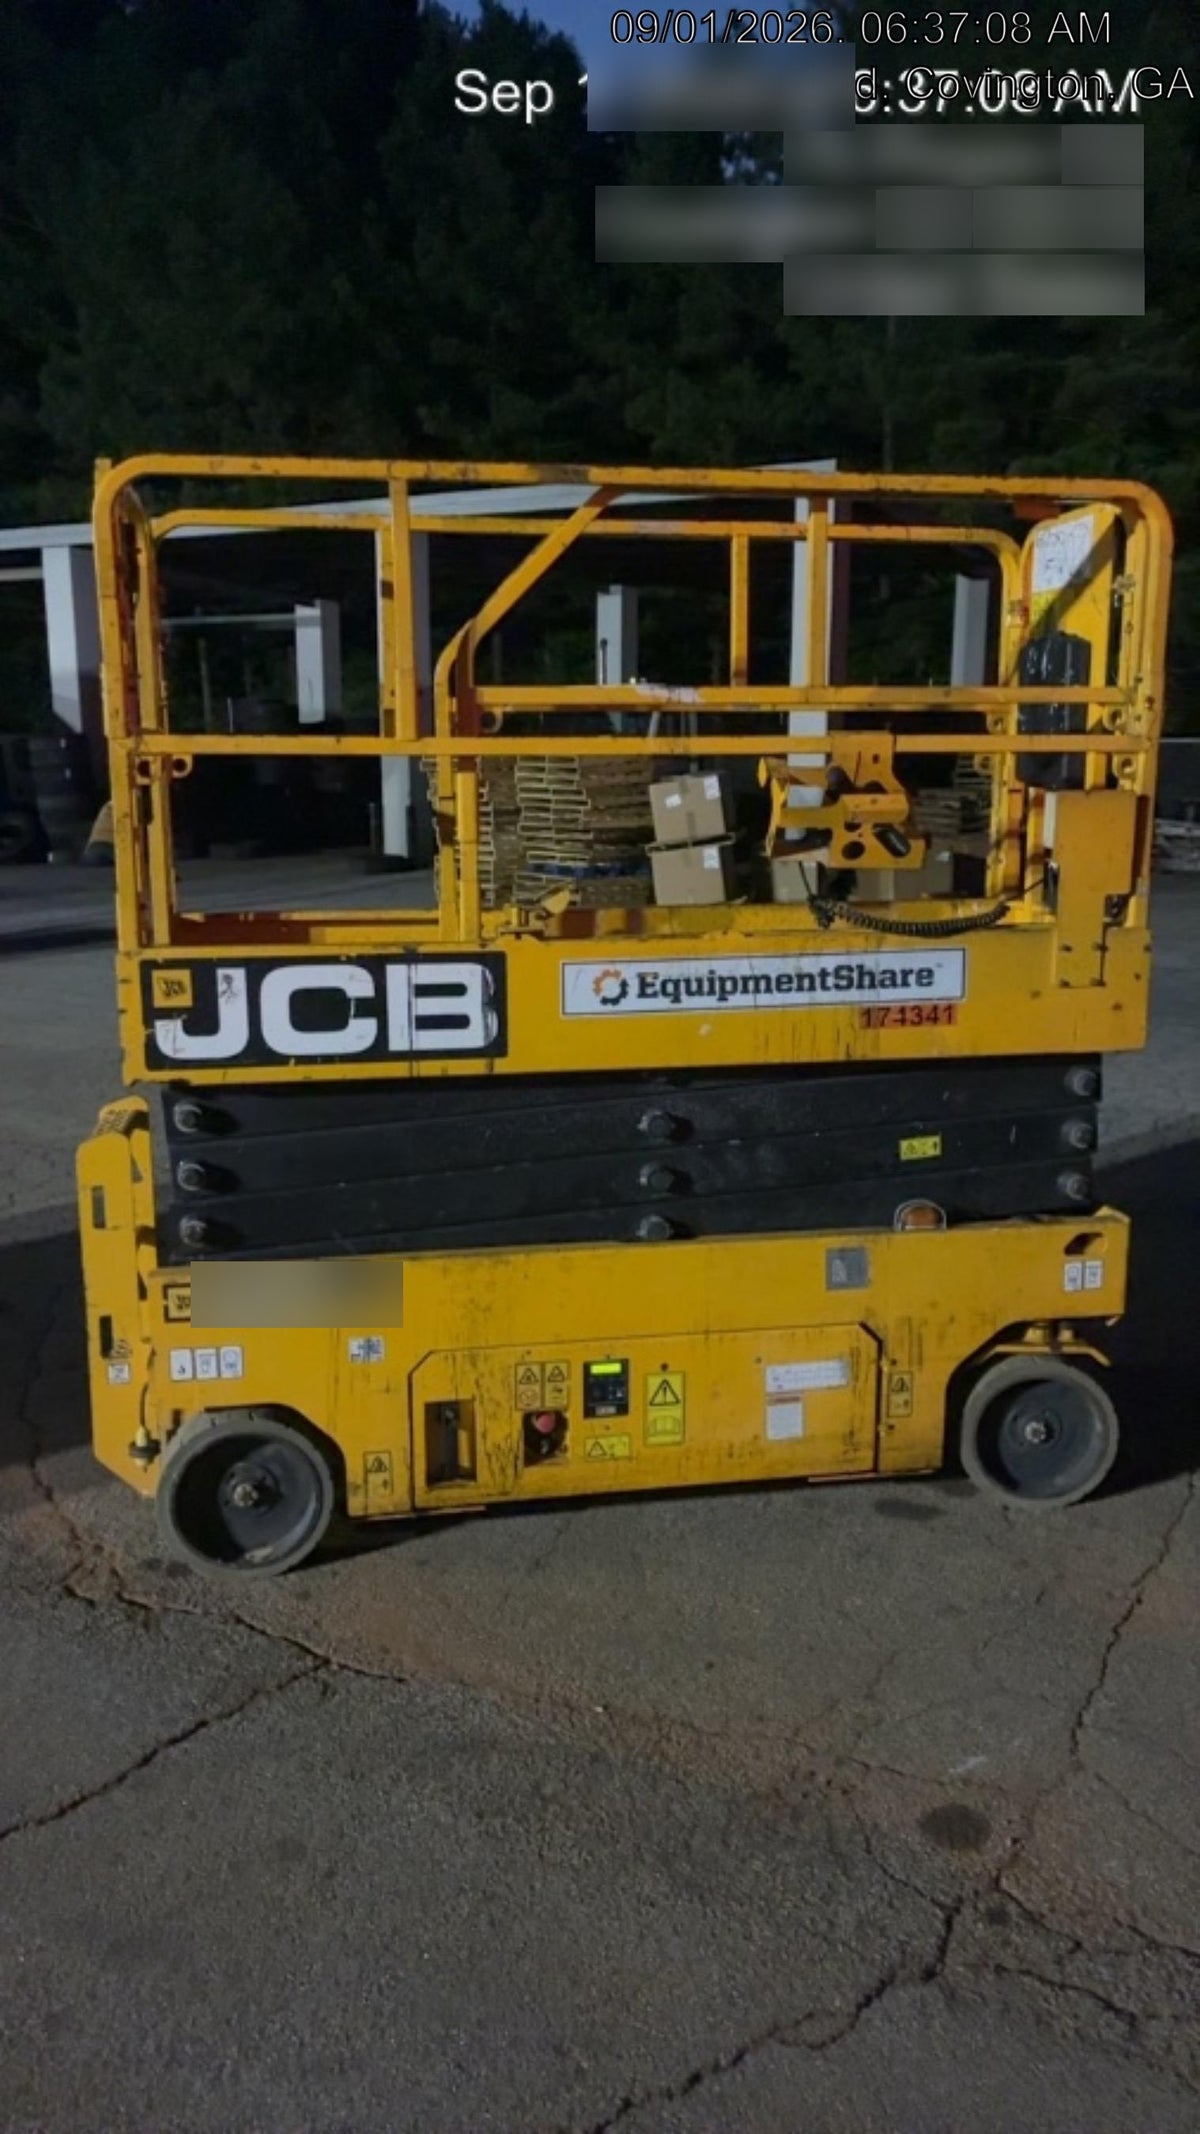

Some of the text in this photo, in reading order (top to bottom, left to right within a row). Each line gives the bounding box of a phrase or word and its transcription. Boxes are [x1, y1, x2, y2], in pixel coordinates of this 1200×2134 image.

[636, 963, 935, 1004] EquipmentShare
[154, 962, 499, 1060] JCB
[860, 1003, 954, 1029] 174341
